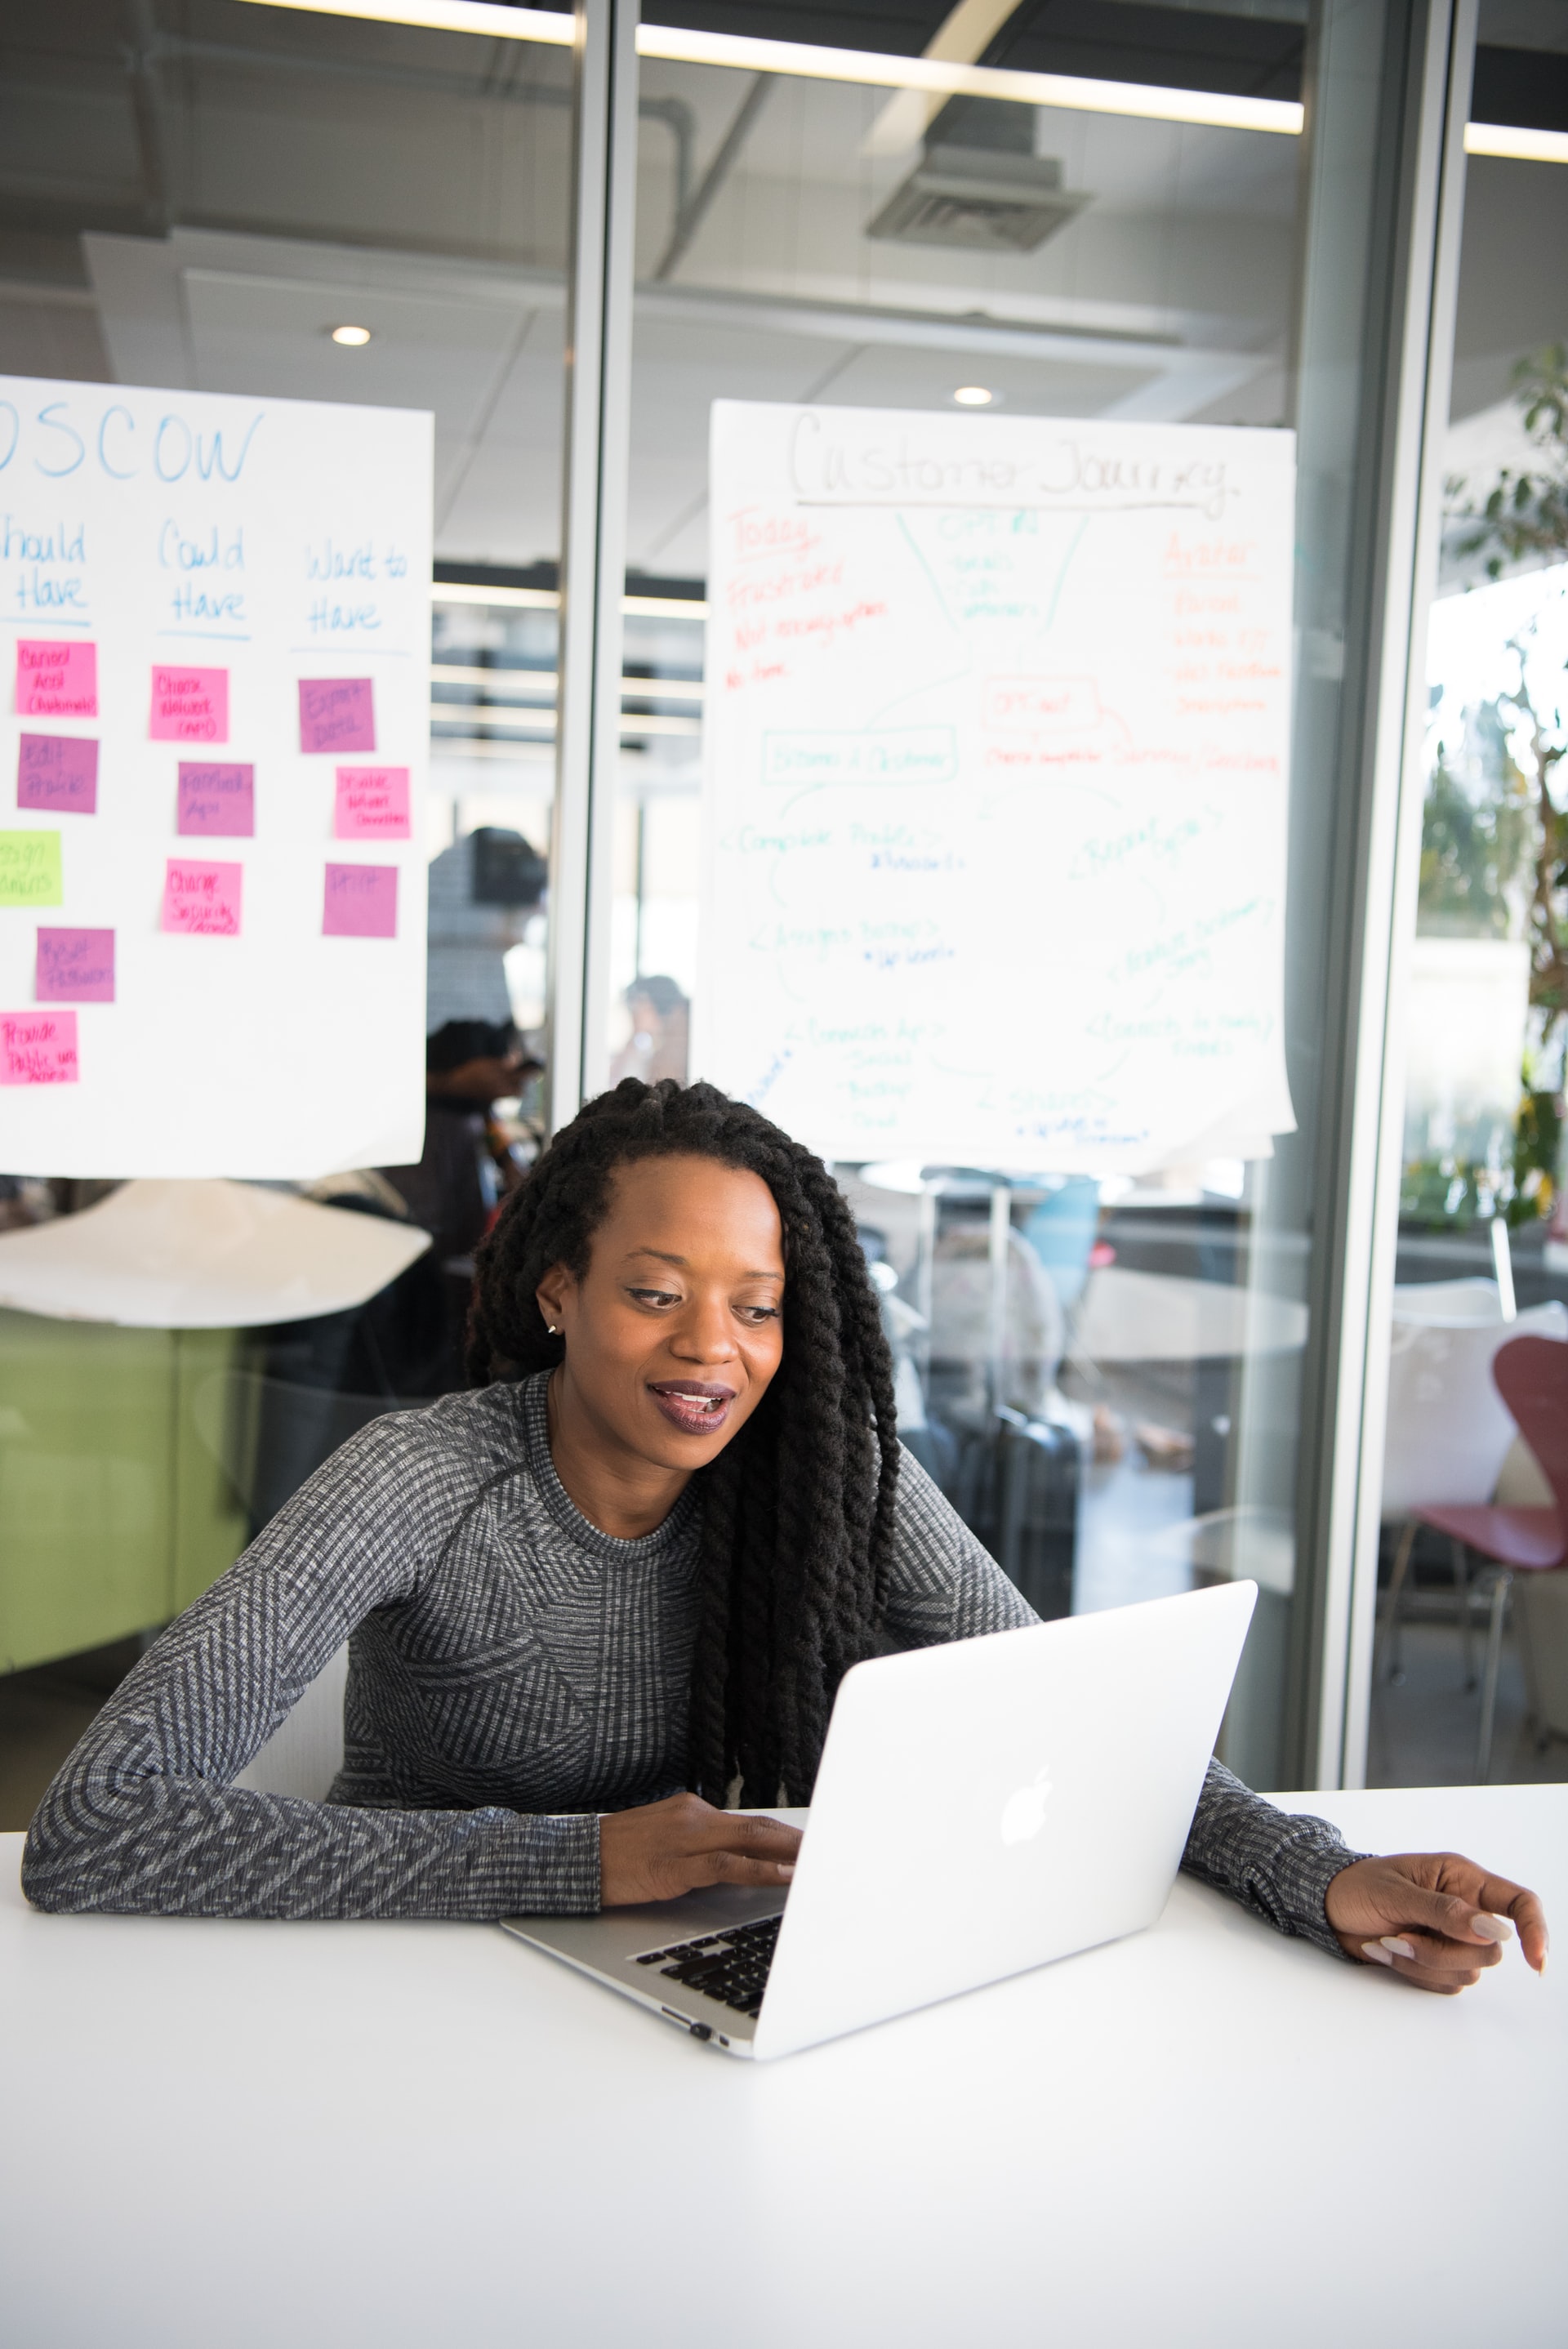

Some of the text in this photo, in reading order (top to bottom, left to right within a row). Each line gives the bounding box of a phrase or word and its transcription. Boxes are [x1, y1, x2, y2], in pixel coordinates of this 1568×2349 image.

[0, 513, 86, 564] hould
[158, 517, 246, 572] Could
[303, 537, 409, 581] Want to
[14, 565, 90, 610] Have
[170, 581, 247, 622] Have
[305, 595, 383, 634] Have
